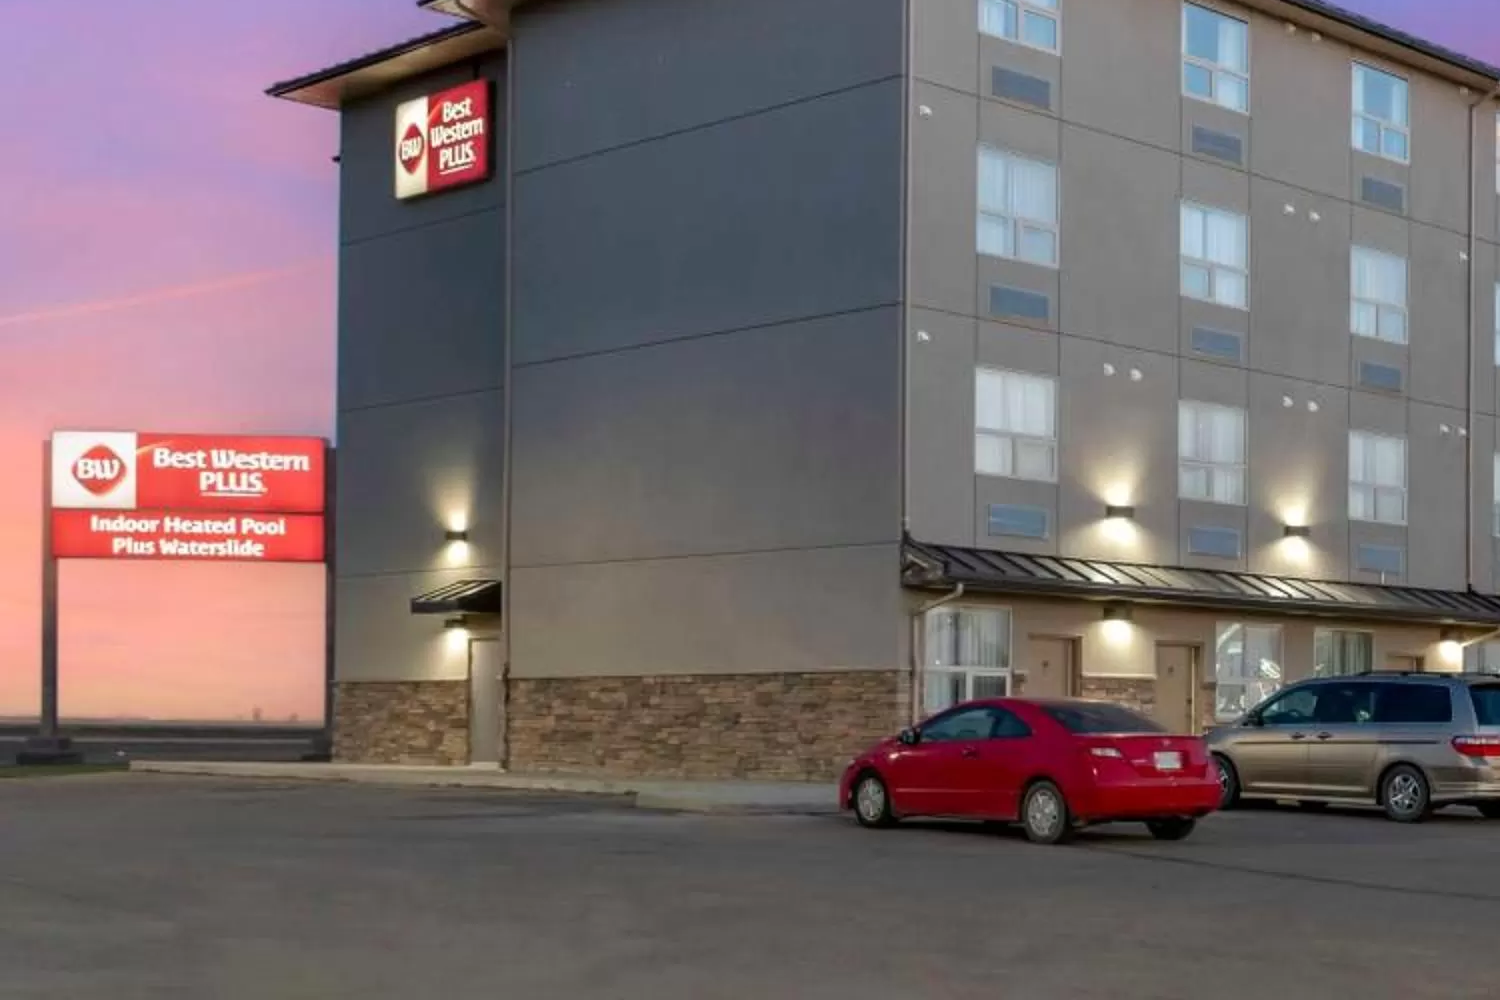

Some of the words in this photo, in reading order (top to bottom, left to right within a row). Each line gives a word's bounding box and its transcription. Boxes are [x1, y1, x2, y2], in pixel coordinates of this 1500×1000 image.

[442, 97, 472, 123] Best
[430, 117, 484, 148] Western
[401, 136, 422, 161] BW
[439, 141, 476, 170] PLUS
[77, 459, 120, 480] BW
[153, 448, 206, 468] Best
[211, 450, 310, 471] Western
[200, 472, 262, 492] PLUS
[91, 515, 159, 532] Indoor
[164, 517, 235, 534] Heated
[242, 518, 285, 535] Pool
[112, 538, 155, 555] Plus
[160, 539, 264, 557] Waterslide
